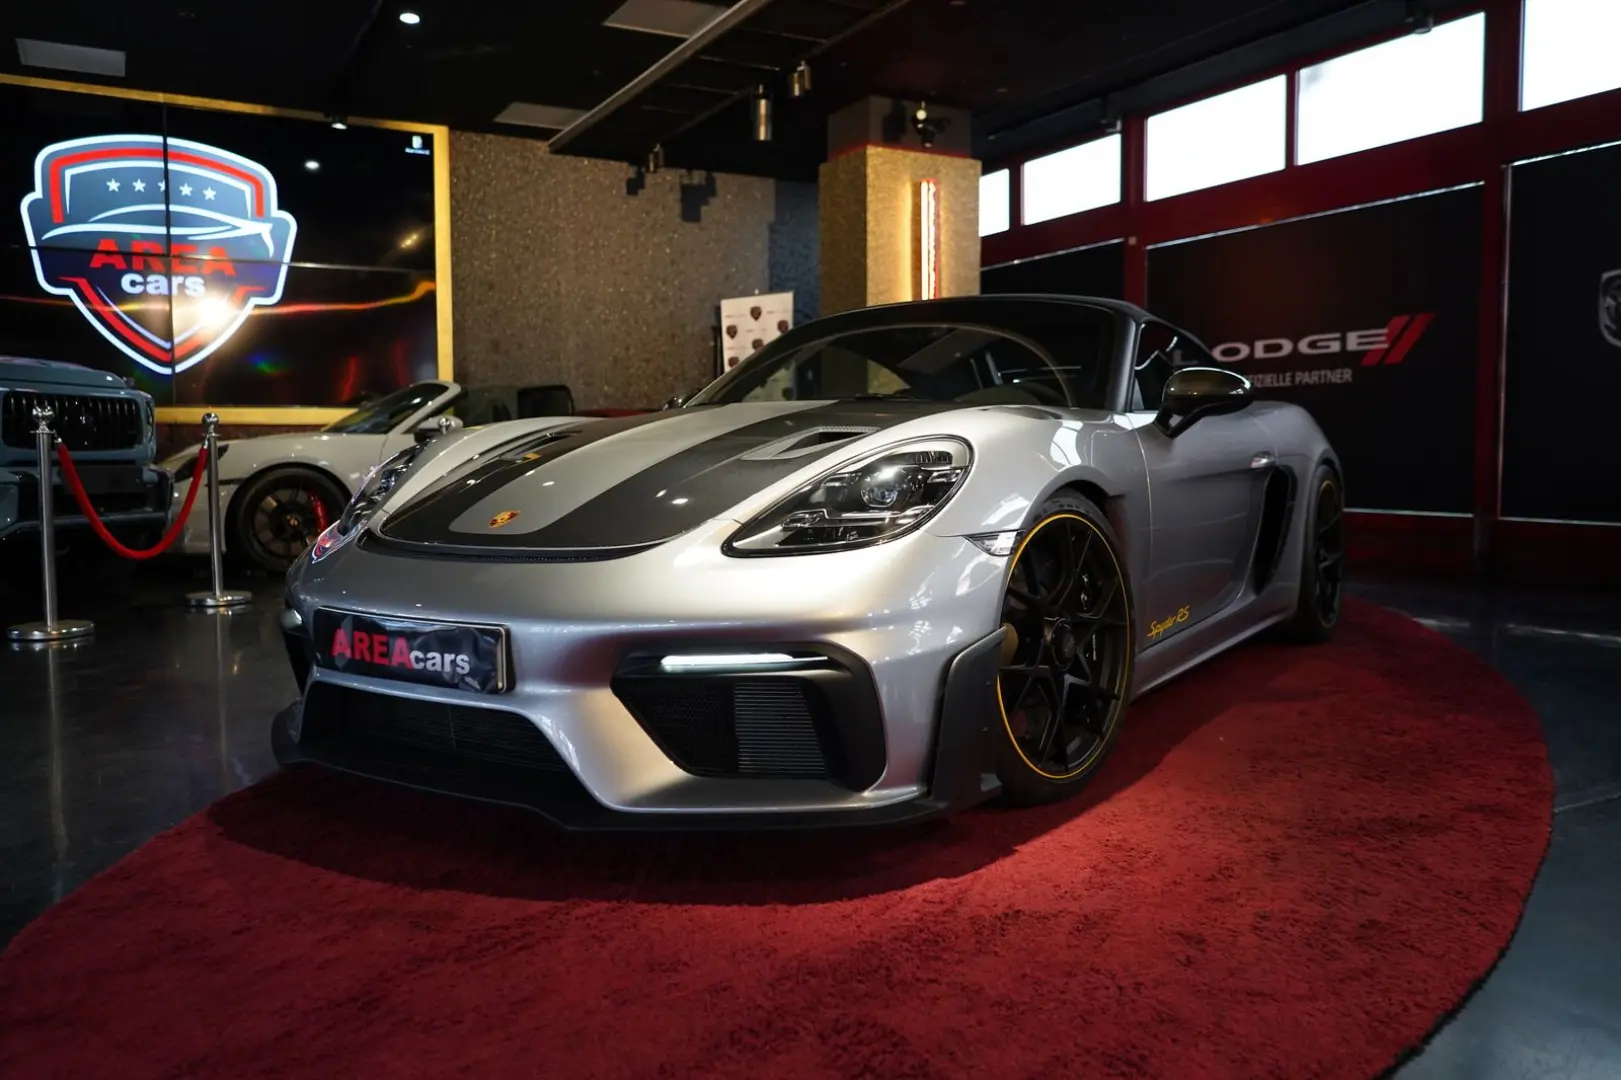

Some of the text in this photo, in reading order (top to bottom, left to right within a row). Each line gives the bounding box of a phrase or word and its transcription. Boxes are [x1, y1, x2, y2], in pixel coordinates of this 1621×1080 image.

[90, 238, 236, 276] AREA
[121, 272, 206, 297] cars
[1295, 368, 1353, 386] PARTNER
